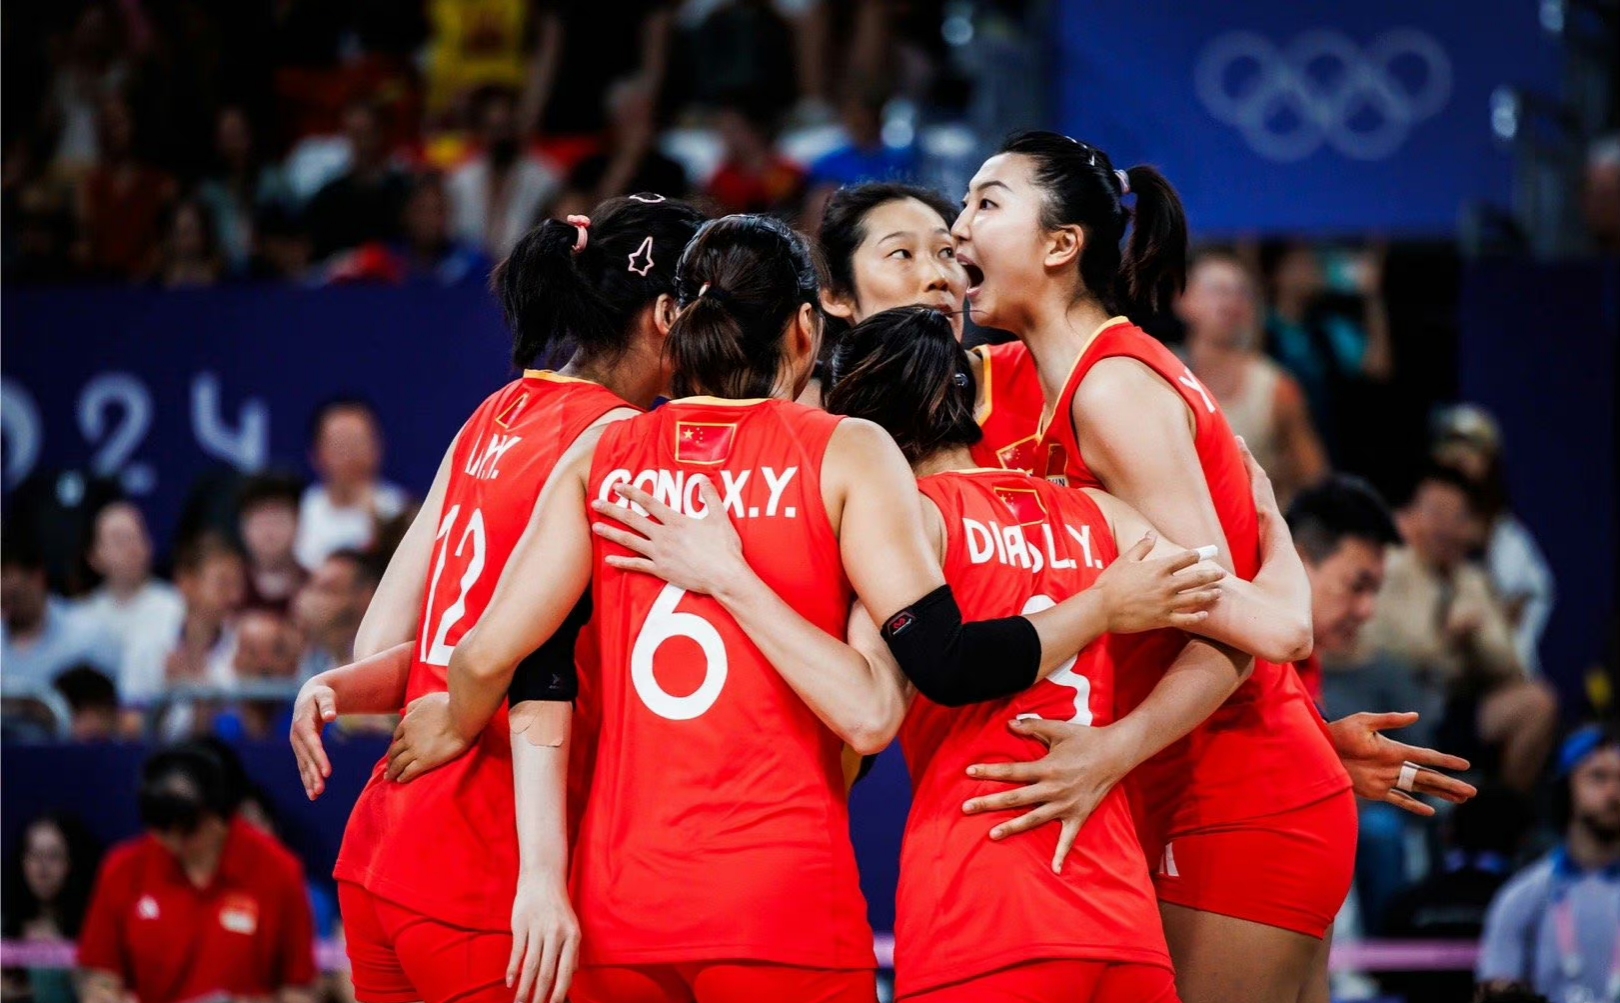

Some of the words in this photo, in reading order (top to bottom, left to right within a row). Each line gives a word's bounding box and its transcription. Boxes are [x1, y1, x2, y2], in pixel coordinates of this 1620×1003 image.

[599, 468, 709, 519] GONG
[720, 466, 799, 518] X.Y.
[419, 504, 487, 667] 12
[1041, 523, 1104, 569] L.Y.
[631, 580, 728, 721] 6
